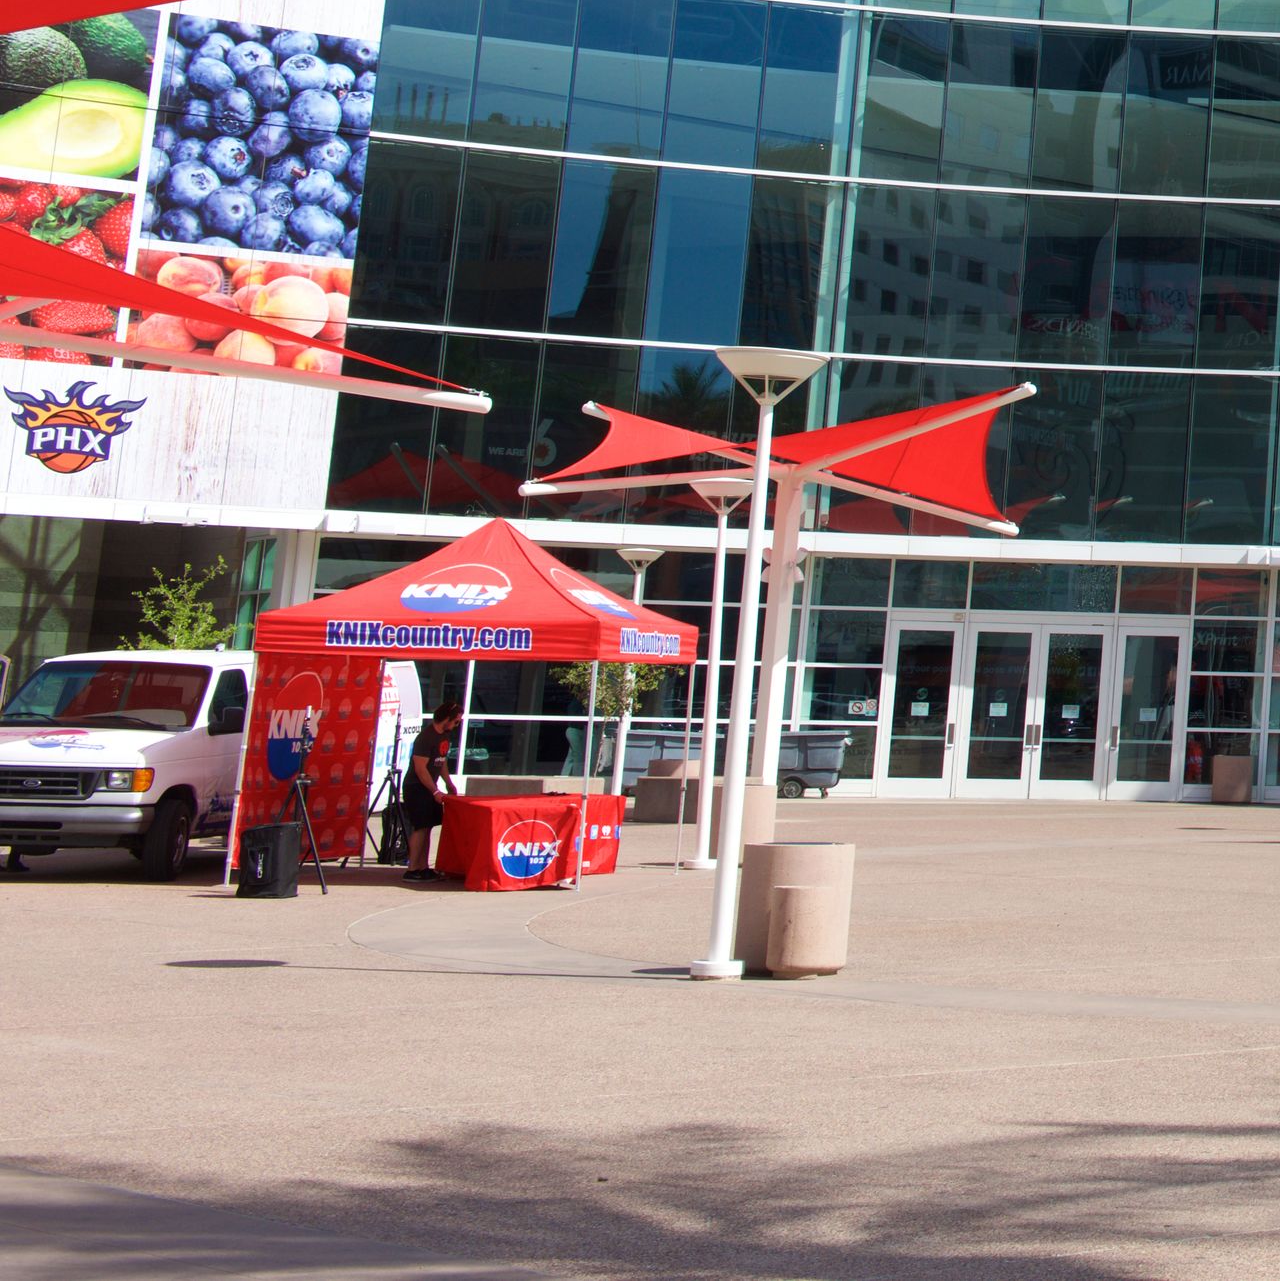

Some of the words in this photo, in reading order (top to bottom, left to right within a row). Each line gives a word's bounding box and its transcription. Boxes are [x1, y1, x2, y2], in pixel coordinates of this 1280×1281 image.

[32, 425, 107, 456] PHX
[488, 446, 504, 456] WE
[400, 583, 513, 601] KNIX
[326, 620, 531, 651] KNIXcountry.com
[268, 709, 322, 739] KNIX
[497, 840, 562, 857] KNIX
